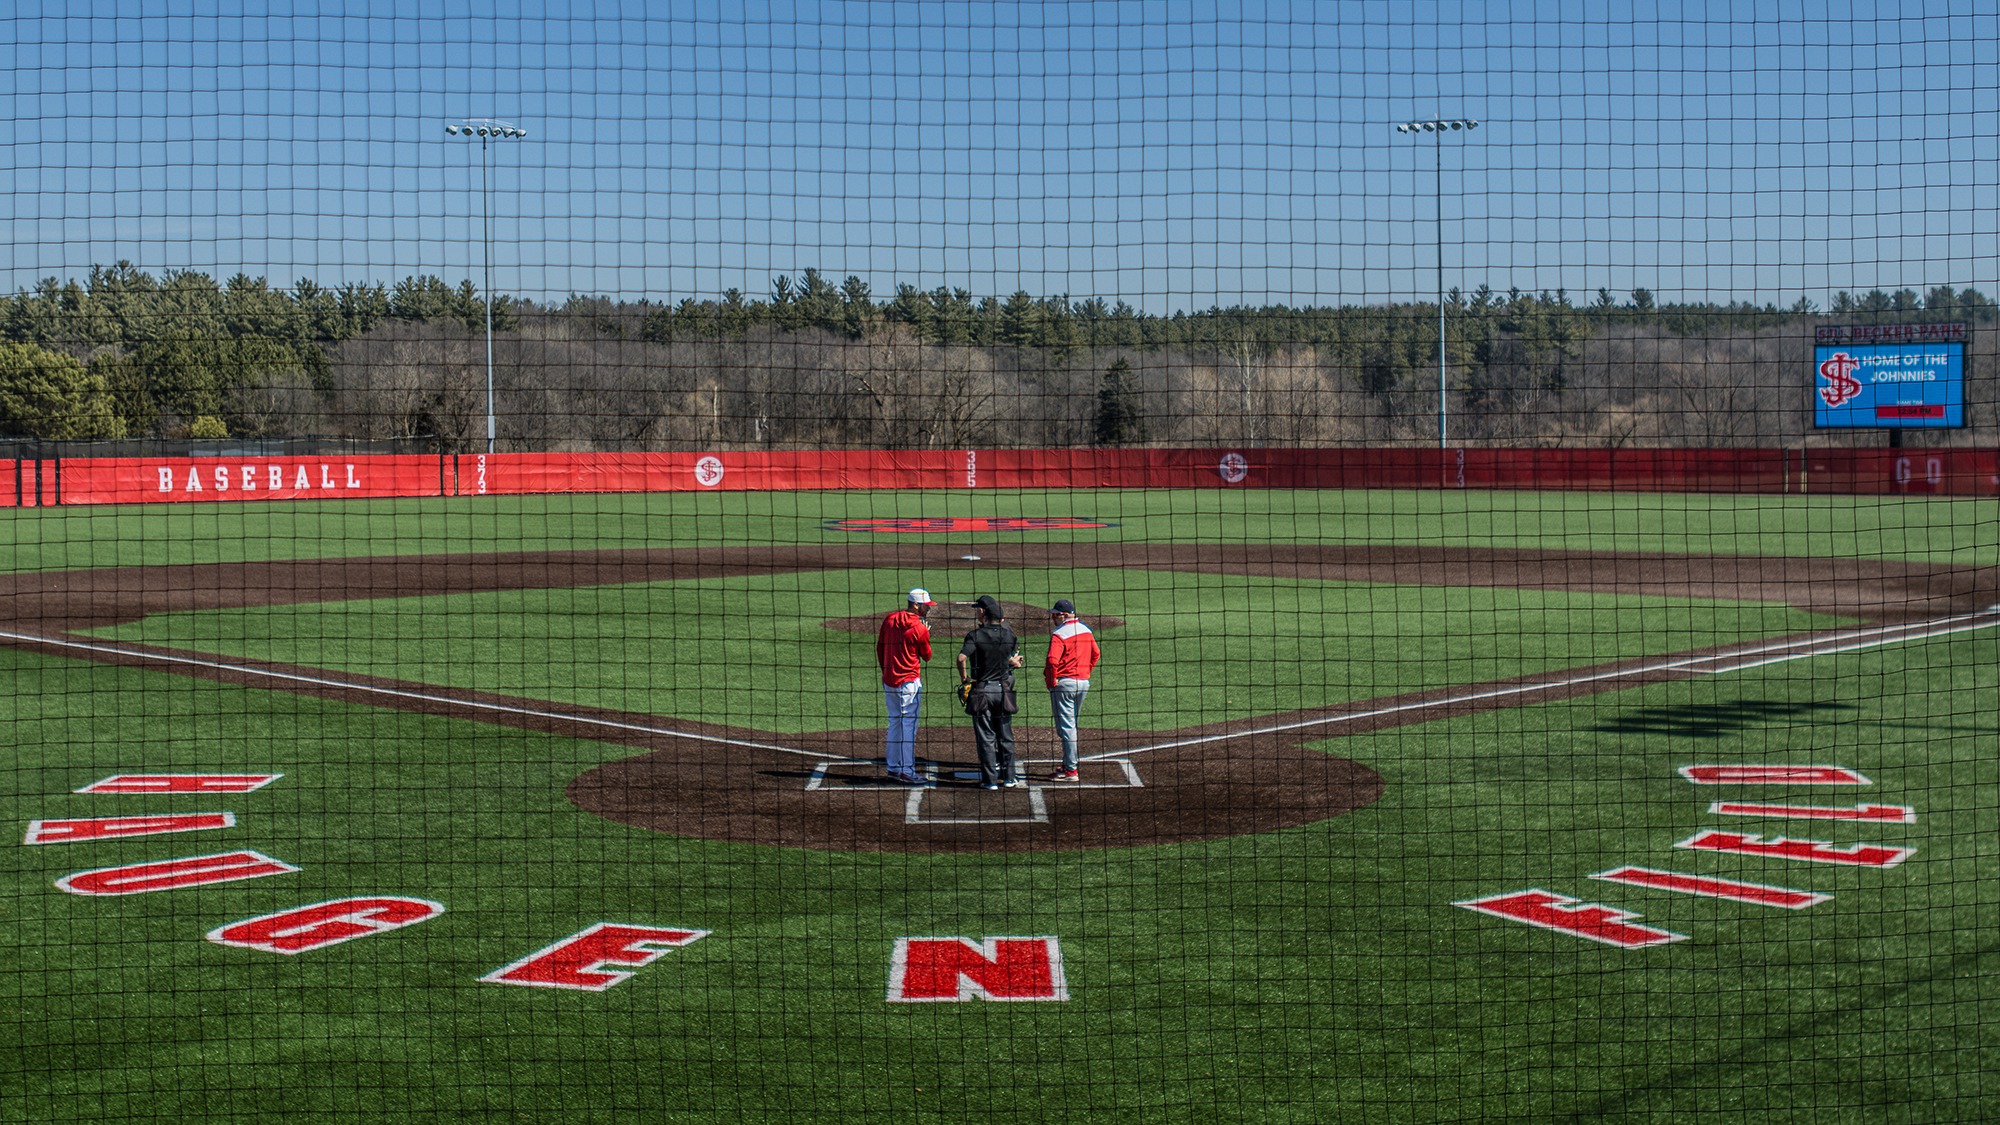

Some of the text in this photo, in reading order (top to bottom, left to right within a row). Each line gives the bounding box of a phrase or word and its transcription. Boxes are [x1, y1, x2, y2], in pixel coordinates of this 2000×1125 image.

[1853, 326, 1913, 339] BECKER
[1919, 324, 1964, 337] PARK
[1863, 353, 1948, 367] HOME OF THE
[1871, 370, 1936, 382] JOHNNIES
[158, 464, 361, 494] BASEBALL
[477, 455, 486, 494] 373
[1895, 456, 1941, 484] GO
[25, 764, 1918, 1003] HAUGEN FIELD
